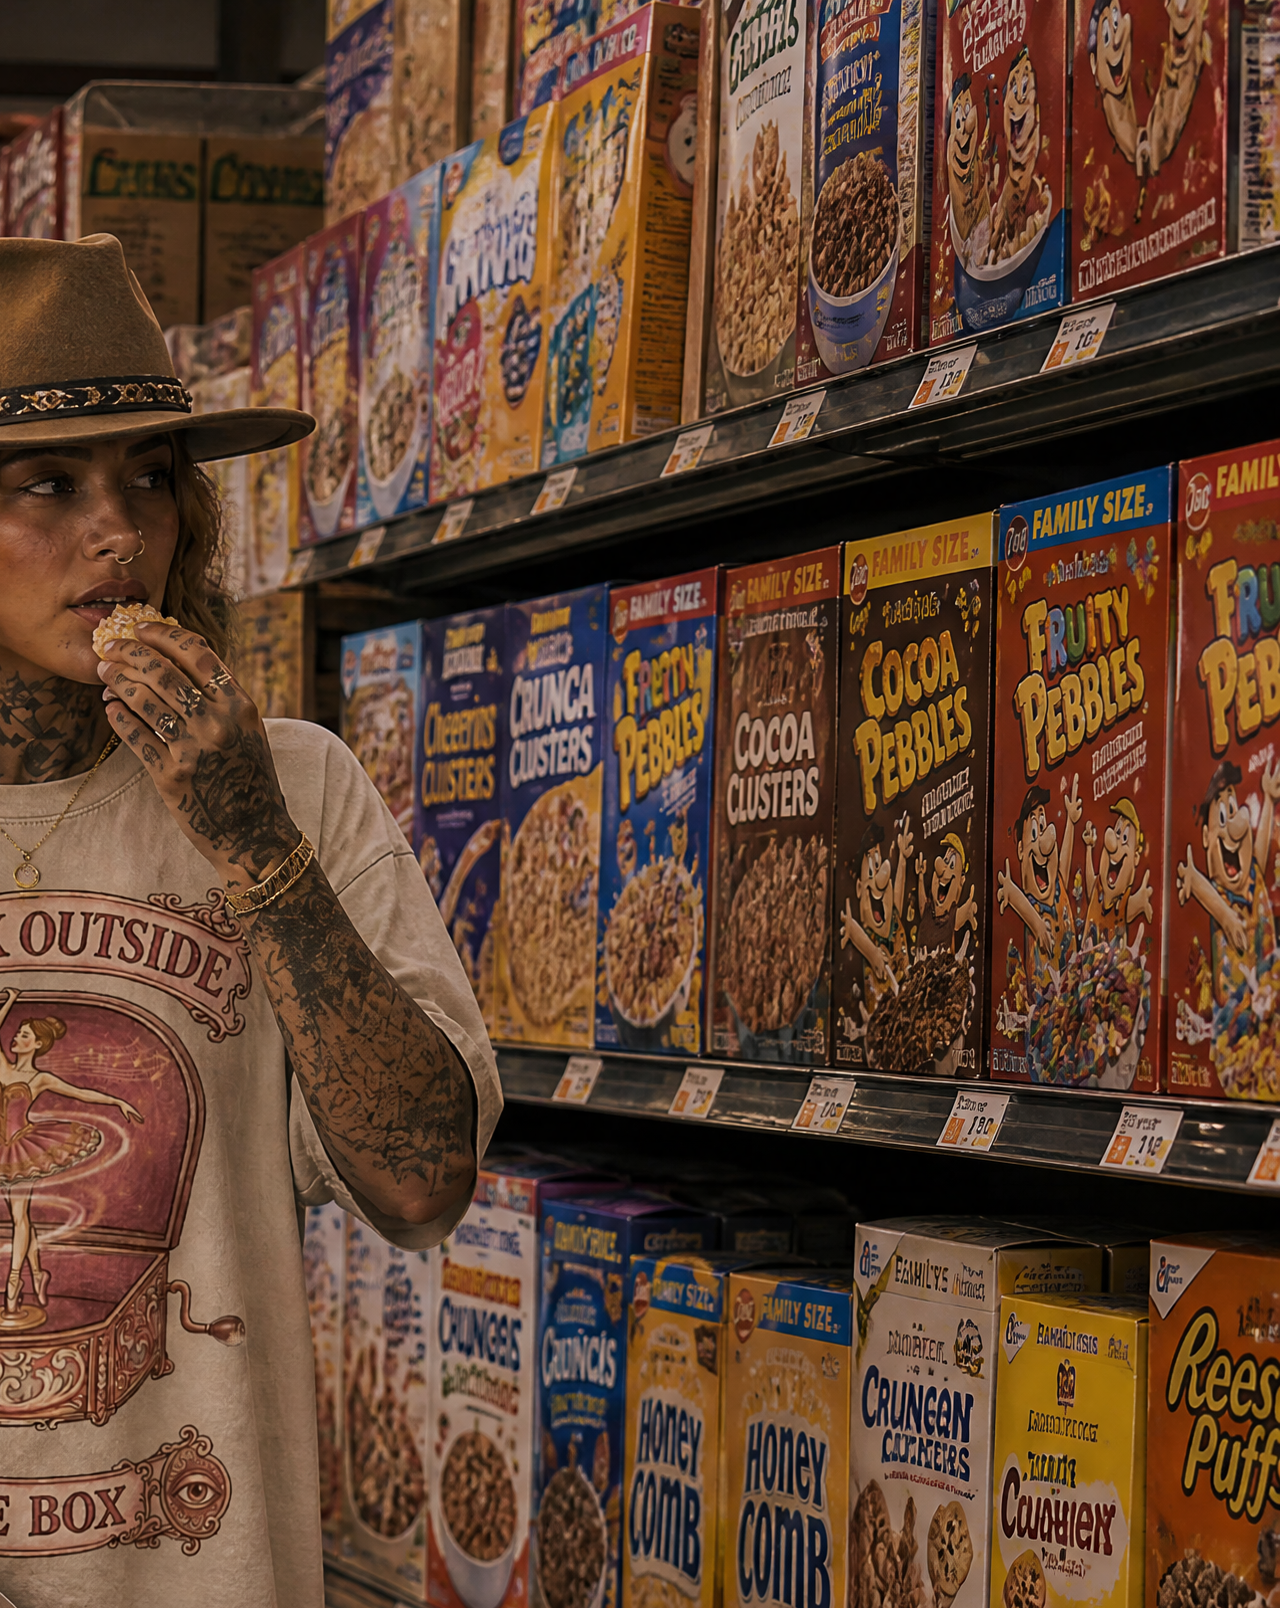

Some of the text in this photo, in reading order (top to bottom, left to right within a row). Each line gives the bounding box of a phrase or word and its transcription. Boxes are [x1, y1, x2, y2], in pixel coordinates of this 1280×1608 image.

[930, 530, 971, 564] SIZE
[1031, 483, 1148, 541] FAMILY SIZE
[1021, 584, 1131, 674] FRUITY
[859, 628, 960, 724] COCOA
[1012, 636, 1147, 779] PEBBLES
[613, 690, 706, 814] PEBBLES
[733, 710, 816, 772] COCOA
[852, 685, 973, 817] PEBBLES
[726, 765, 820, 827] CLUSTERS
[18, 908, 236, 1000] OUTSIDE
[28, 1485, 128, 1537] BOX
